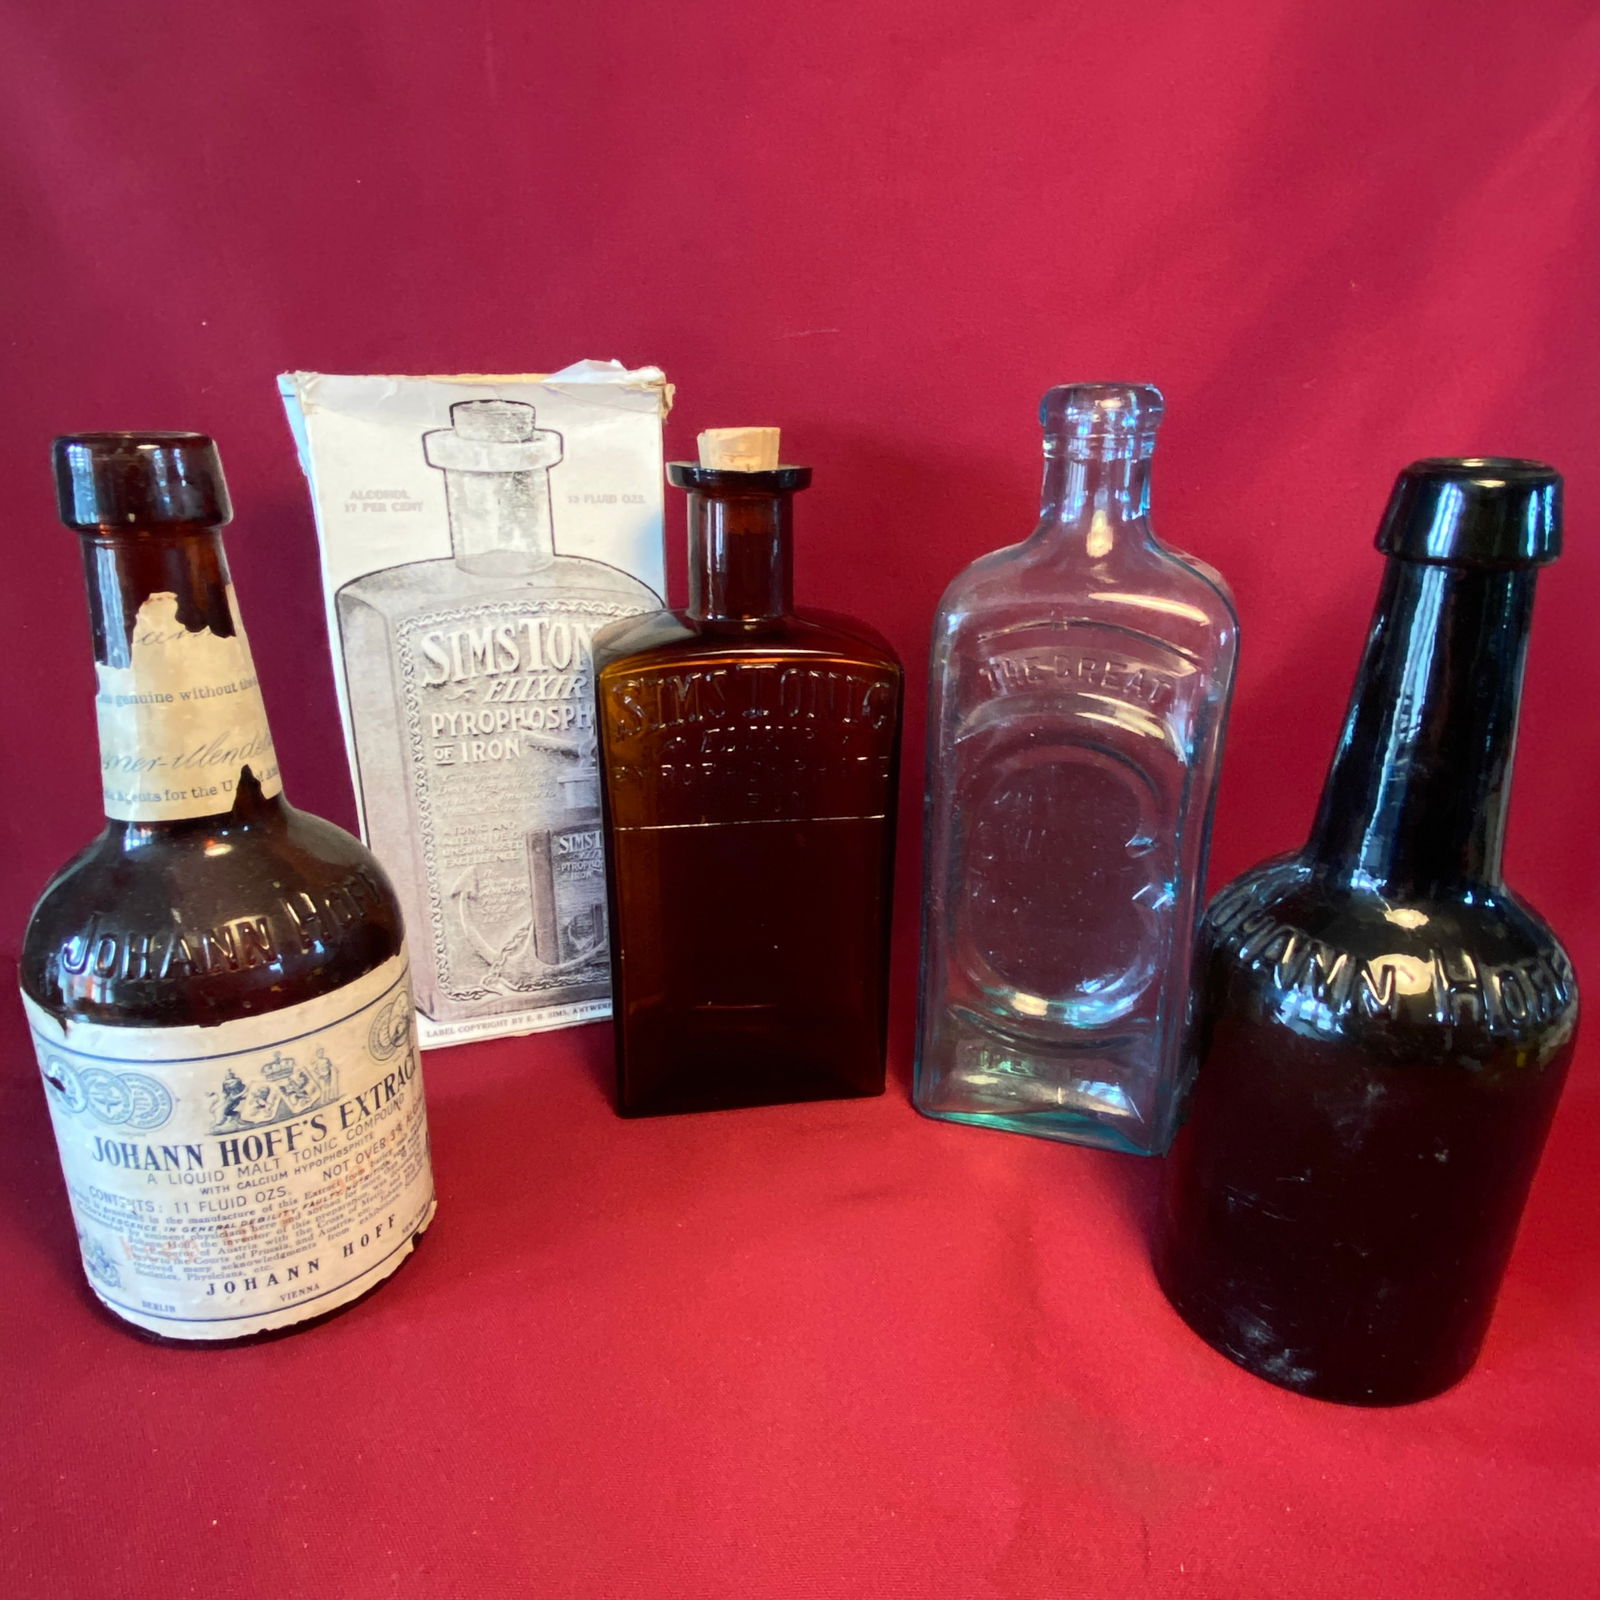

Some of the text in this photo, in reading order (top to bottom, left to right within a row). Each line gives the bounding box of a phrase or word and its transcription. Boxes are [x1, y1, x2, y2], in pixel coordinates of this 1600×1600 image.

[362, 502, 387, 513] PER
[391, 501, 424, 513] CENT
[419, 624, 520, 688] SIMS
[179, 682, 238, 701] without
[483, 675, 589, 703] ELIXIR
[434, 737, 521, 763] OF IRON
[165, 788, 187, 801] for
[191, 784, 218, 799] the
[62, 910, 280, 980] JOHANN
[426, 1027, 455, 1038] LABEL
[457, 1019, 508, 1034] COPYRIGHT
[92, 1135, 204, 1171] JOHANN
[218, 1112, 327, 1168] HOFF'S
[147, 1092, 405, 1186] A LIQUID MALT TONIC COMPOUND
[174, 1201, 189, 1214] 11
[199, 1195, 247, 1213] FLUID
[323, 1159, 350, 1181] NOT
[355, 1136, 386, 1166] OVER
[200, 1185, 231, 1196] WITH
[237, 1170, 288, 1190] CALCIUM
[262, 1203, 273, 1213] of
[206, 1213, 395, 1297] JOHANN HOFF
[279, 1282, 321, 1303] VIENNA
